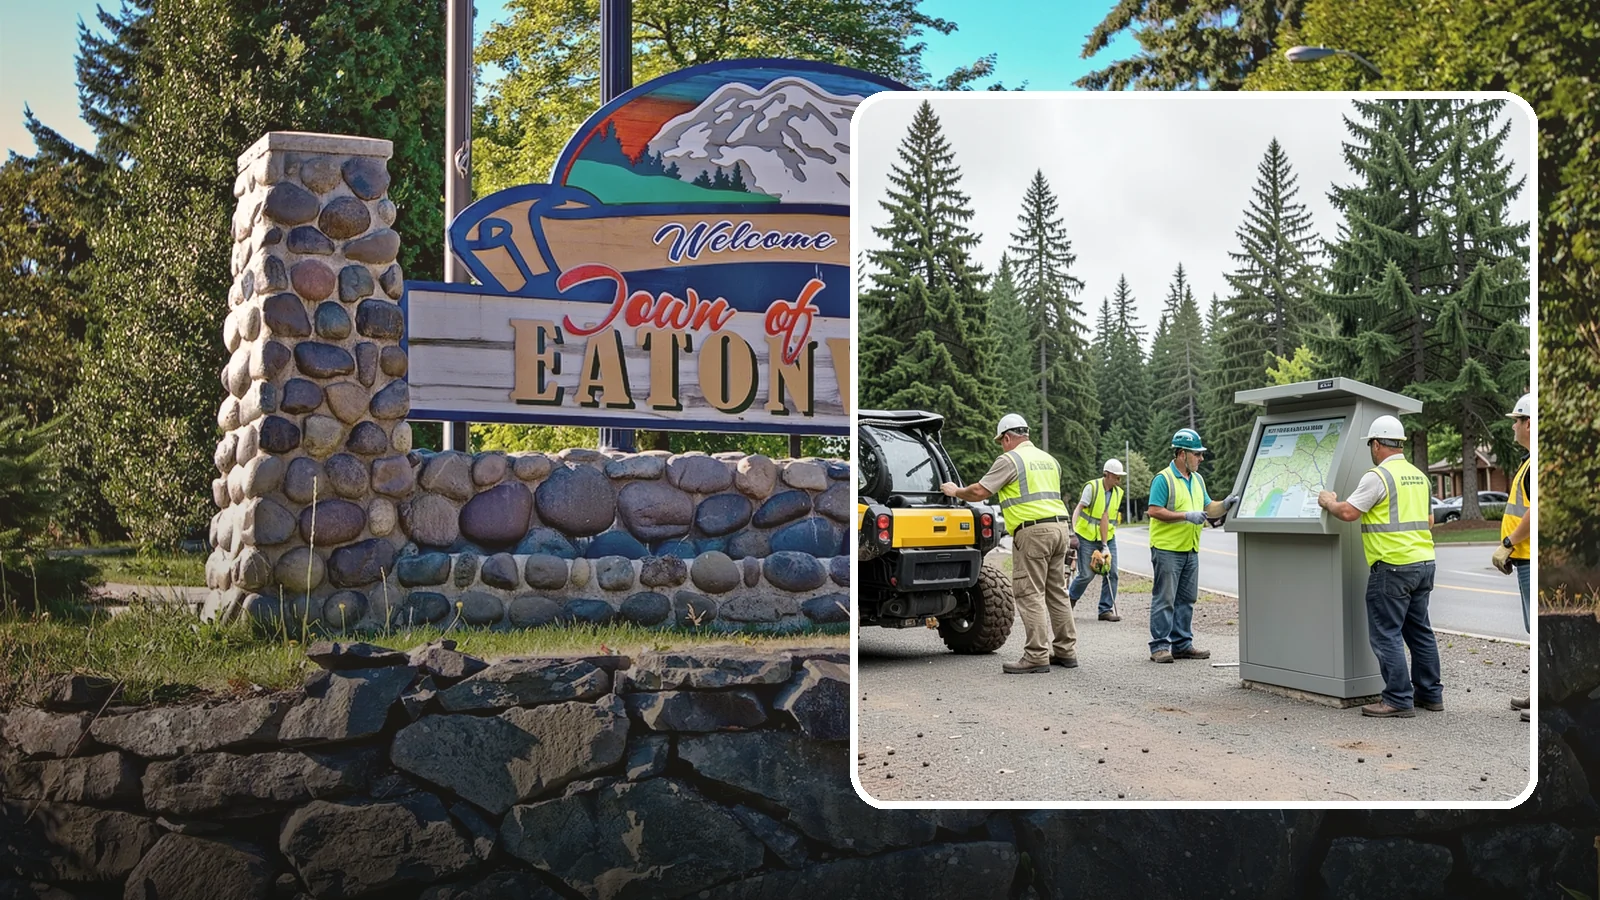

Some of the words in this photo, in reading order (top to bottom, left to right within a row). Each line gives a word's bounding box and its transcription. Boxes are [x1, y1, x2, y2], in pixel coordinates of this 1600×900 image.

[653, 220, 837, 264] Welcome
[556, 264, 736, 336] Town
[764, 279, 827, 366] of
